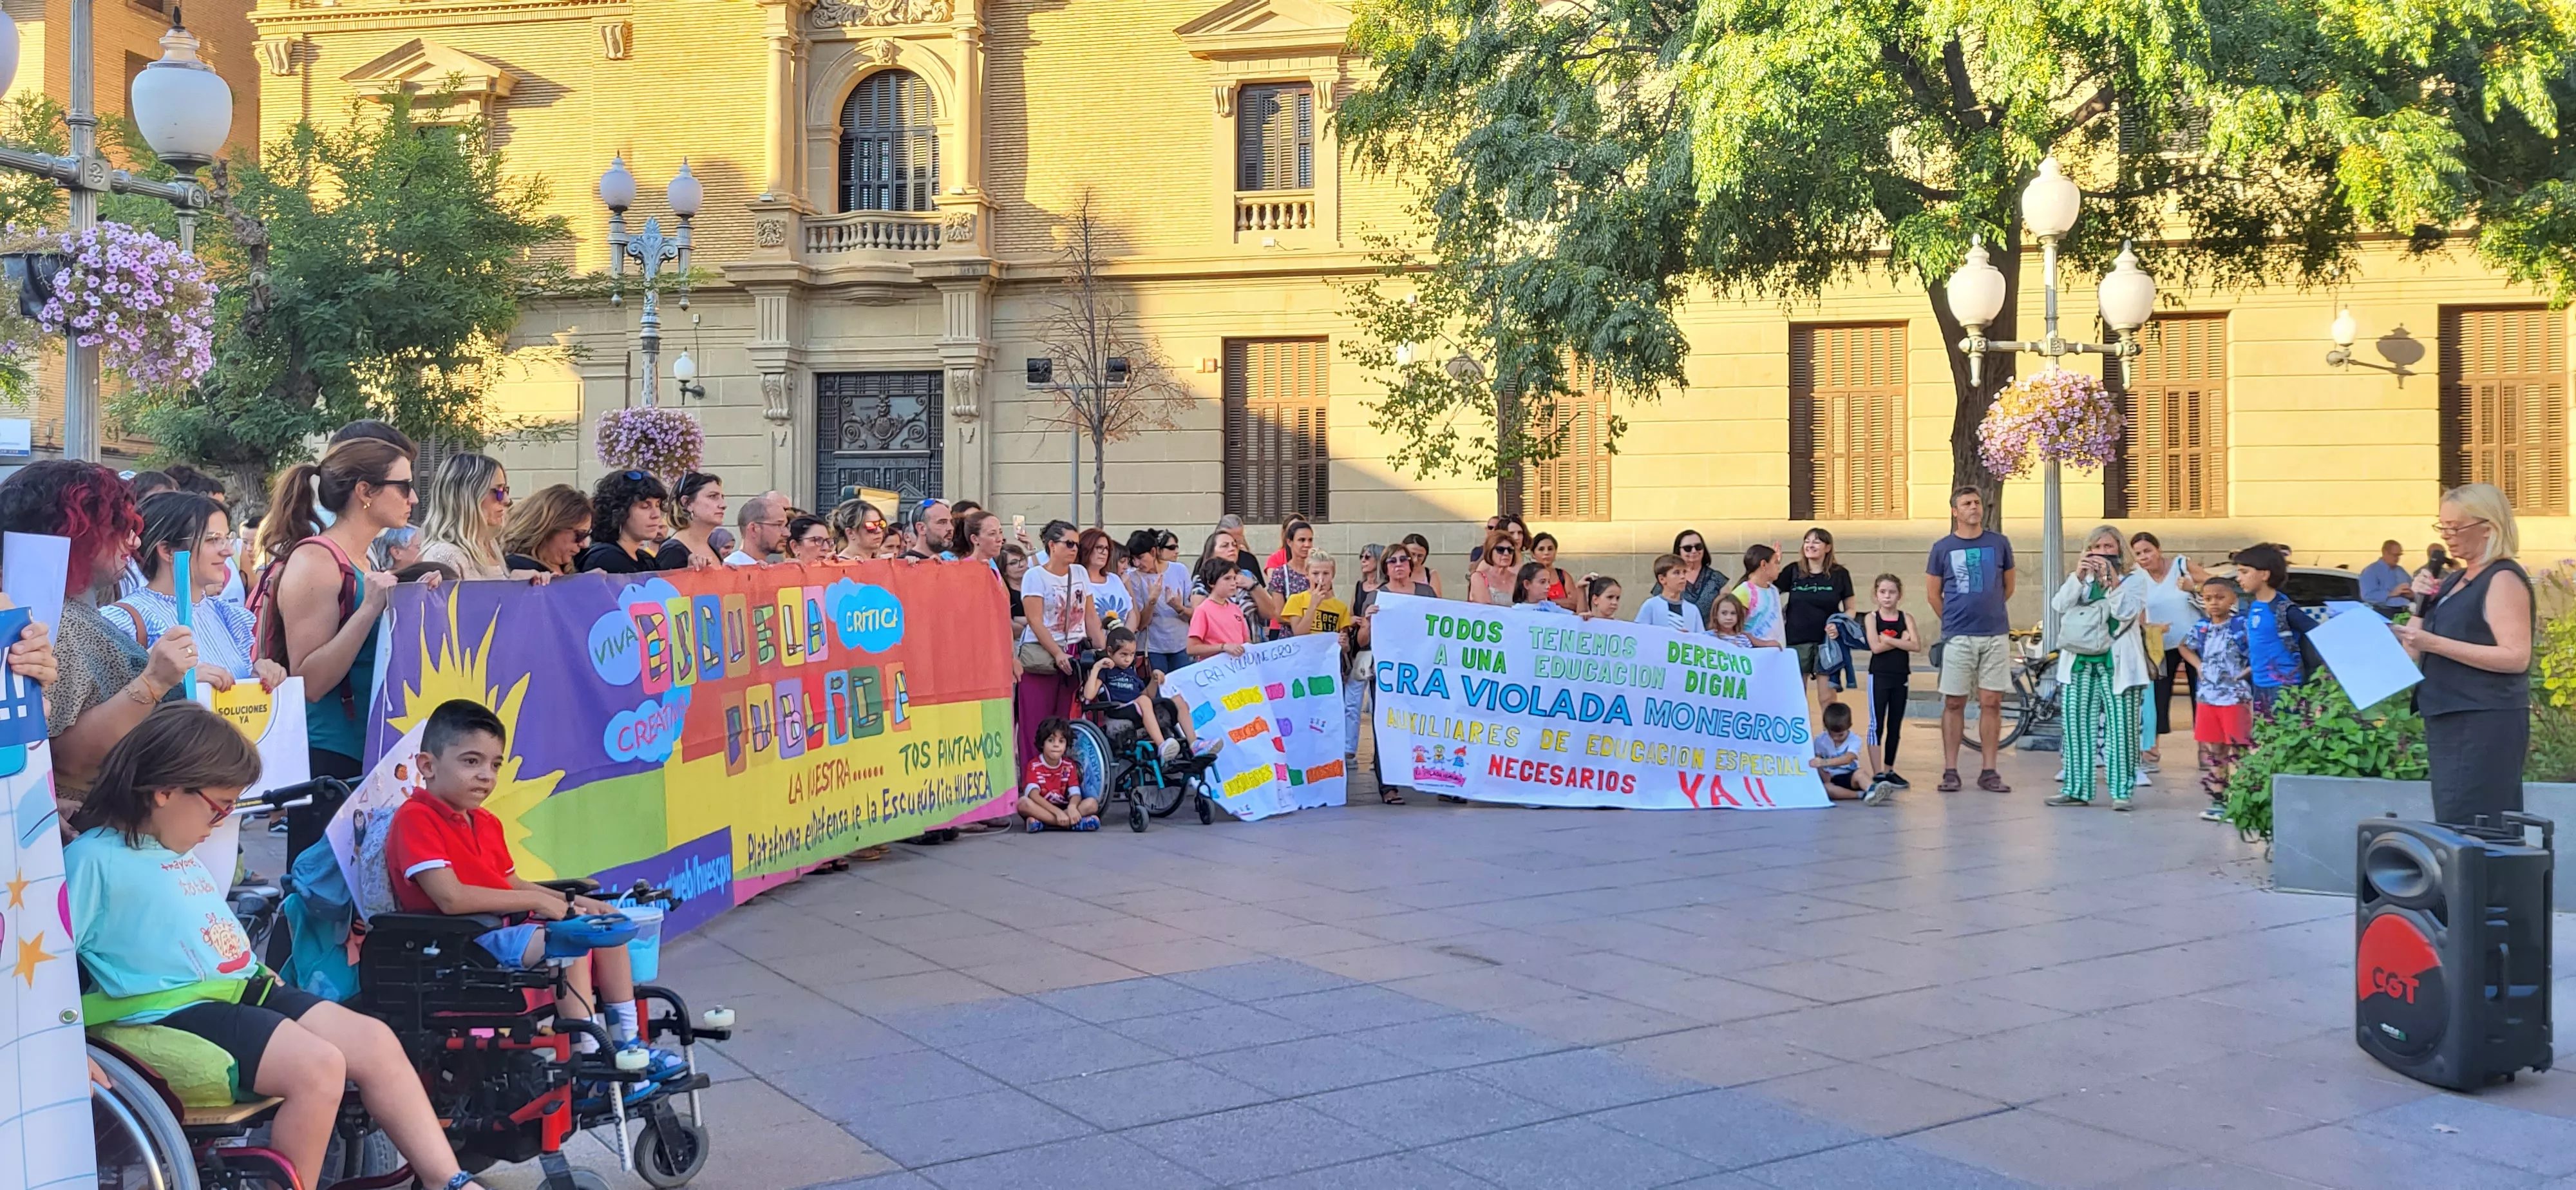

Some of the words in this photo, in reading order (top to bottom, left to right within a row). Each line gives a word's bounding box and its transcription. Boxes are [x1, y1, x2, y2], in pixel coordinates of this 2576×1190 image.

[594, 625, 638, 665] VIVA
[635, 598, 826, 683] ESCUELA
[1425, 614, 1503, 643] TODOS
[1529, 626, 1638, 659] TENEMOS
[1668, 641, 1753, 675] DERECHO
[1195, 666, 1225, 687] CRA
[1434, 643, 1448, 666] A
[1462, 647, 1506, 674] UNA
[1535, 655, 1666, 690] EDUCACION
[1685, 670, 1747, 700] DIGNA
[218, 704, 267, 716] SOLUCIONES
[239, 715, 249, 724] YA
[1377, 661, 1450, 700] CRA
[1461, 675, 1633, 726] VIOLADA
[1644, 697, 1808, 744] MONEGROS
[938, 732, 1003, 768] PINTAMOS
[1387, 707, 1520, 748] AUXILIARES
[1540, 728, 1571, 752] DE
[1586, 734, 1705, 770] EDUCACION
[1716, 748, 1808, 776] ESPECIAL
[788, 772, 804, 804] LA
[1488, 754, 1636, 794] NECESARIOS
[748, 825, 800, 872] Plataforma
[867, 793, 876, 827] la
[954, 770, 993, 805] HUESCA
[2372, 966, 2420, 1005] CGT
